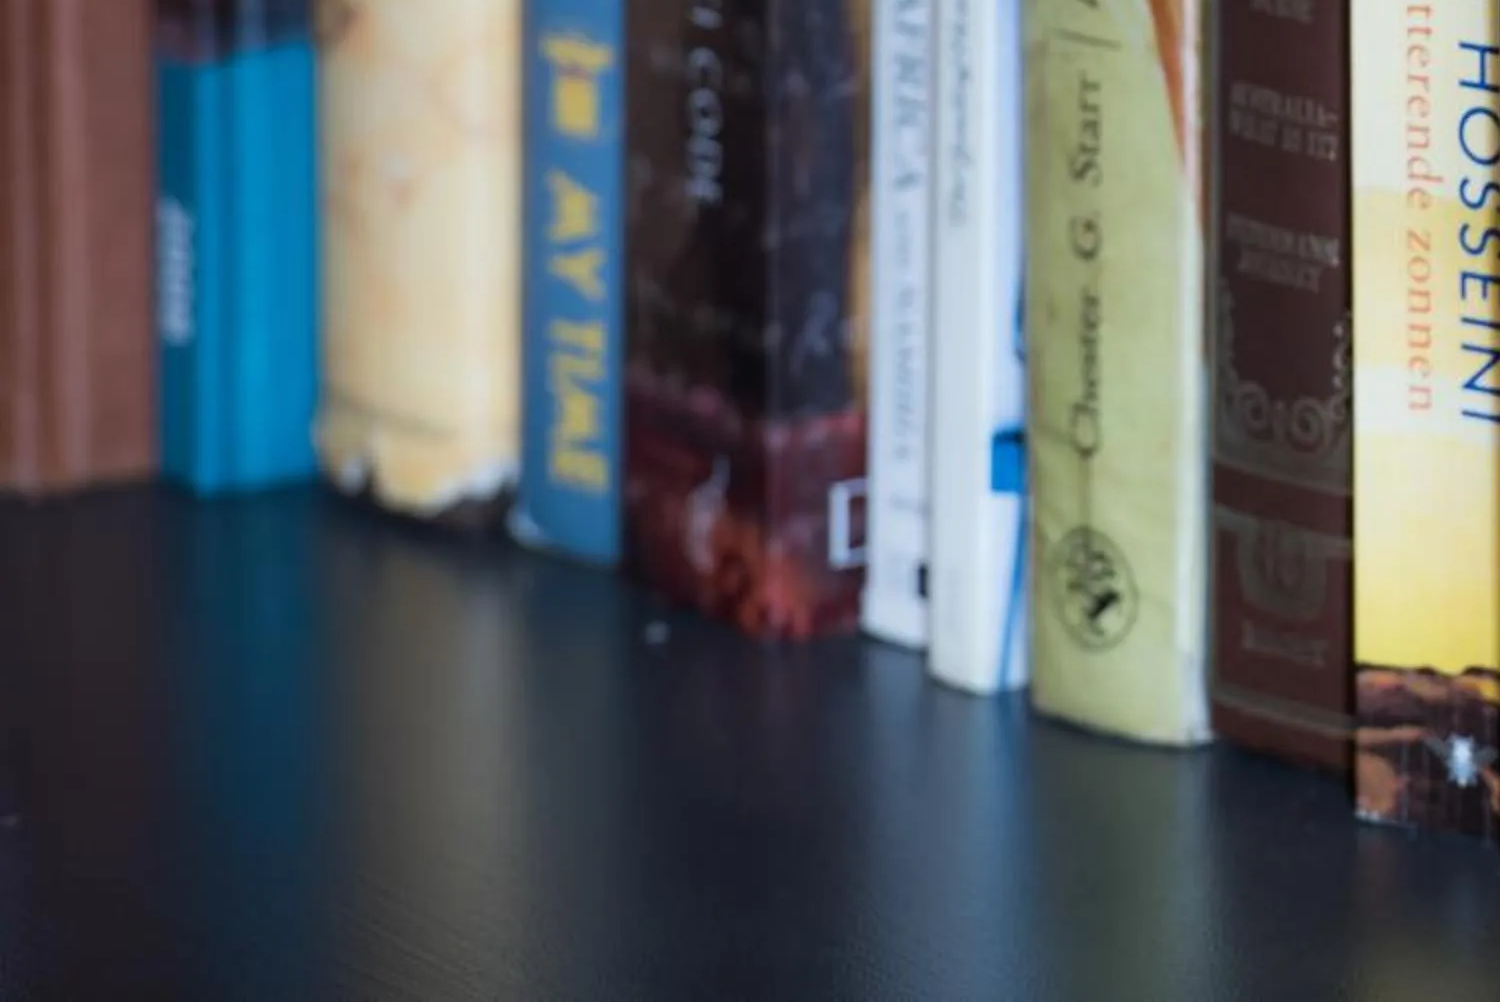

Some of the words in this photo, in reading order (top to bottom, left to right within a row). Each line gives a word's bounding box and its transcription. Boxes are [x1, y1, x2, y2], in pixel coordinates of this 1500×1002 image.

[685, 44, 724, 204] CODE
[1067, 71, 1102, 189] Starr
[547, 172, 609, 304] MY
[1404, 224, 1437, 416] zonnen
[549, 318, 610, 495] TIME
[1069, 286, 1104, 461] Chester
